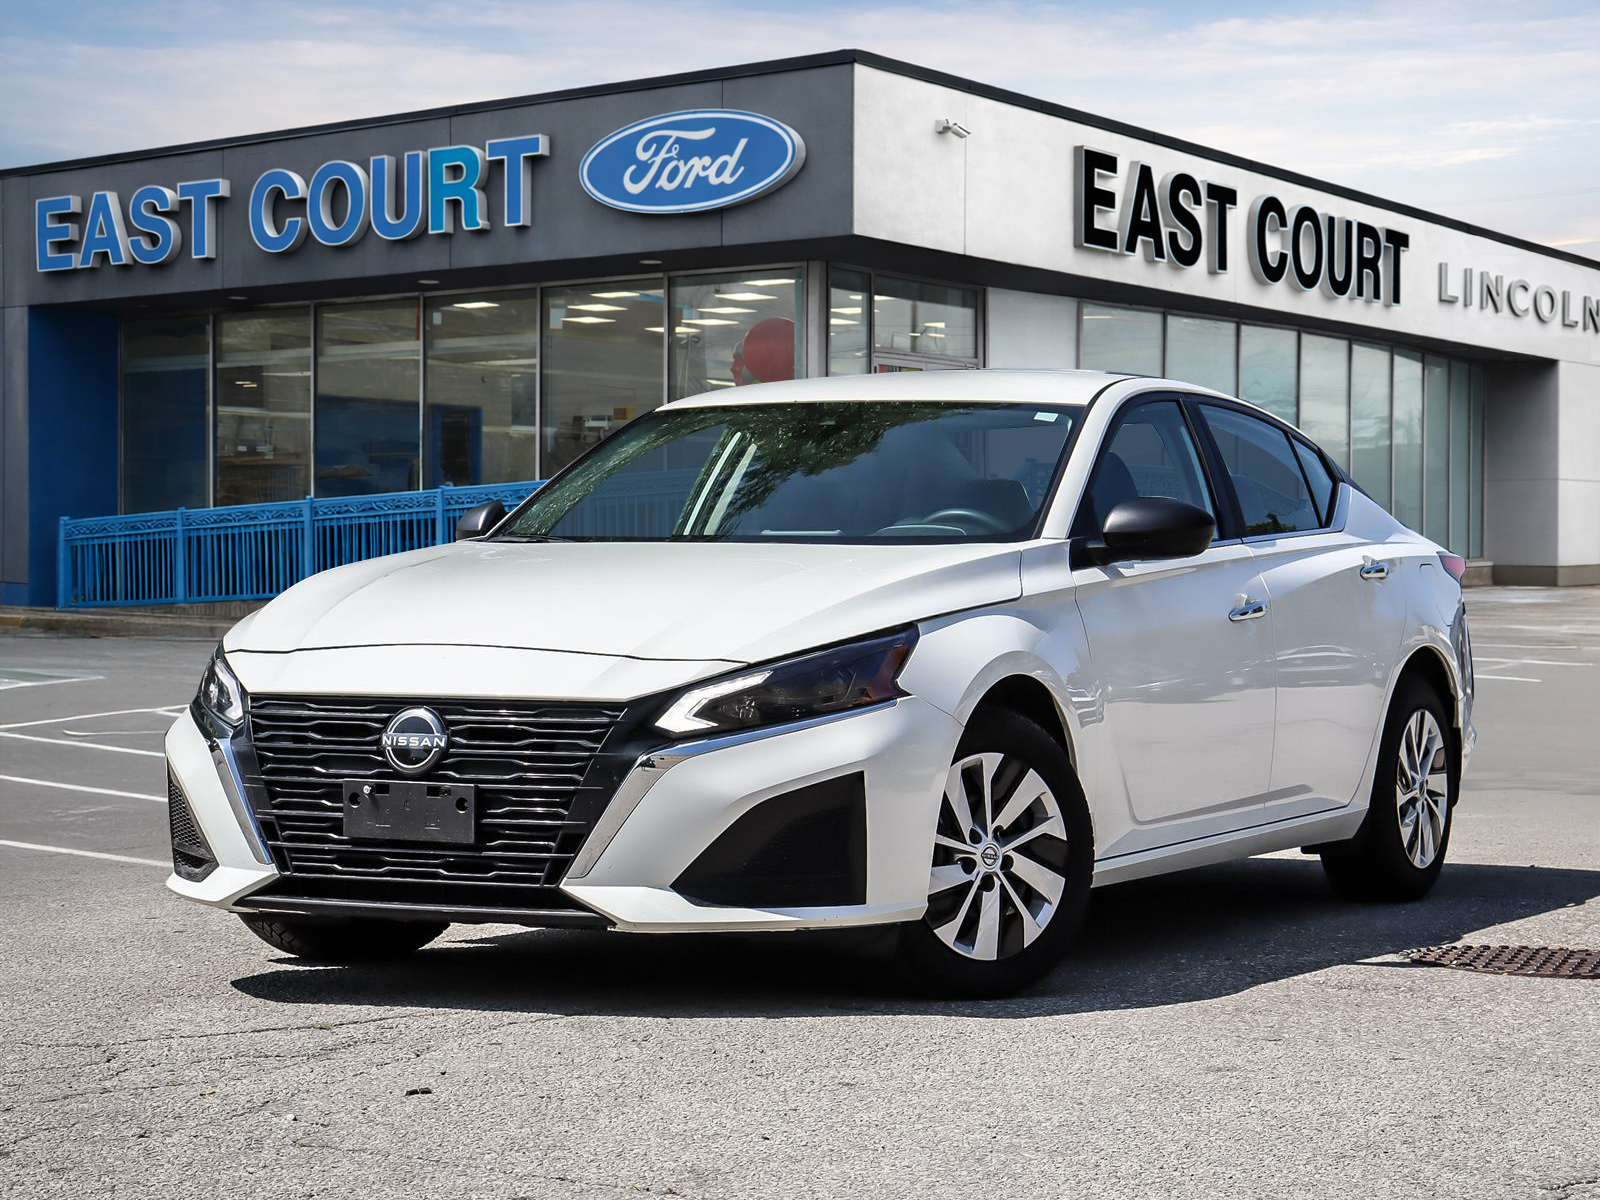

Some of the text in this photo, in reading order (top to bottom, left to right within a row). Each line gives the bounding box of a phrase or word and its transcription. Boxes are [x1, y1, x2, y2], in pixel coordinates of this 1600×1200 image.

[623, 127, 749, 195] Ford
[36, 134, 549, 272] EAST COURT
[1074, 145, 1410, 307] EAST COURT
[1438, 261, 1600, 334] LINCOLN
[382, 736, 446, 747] NISSAN
